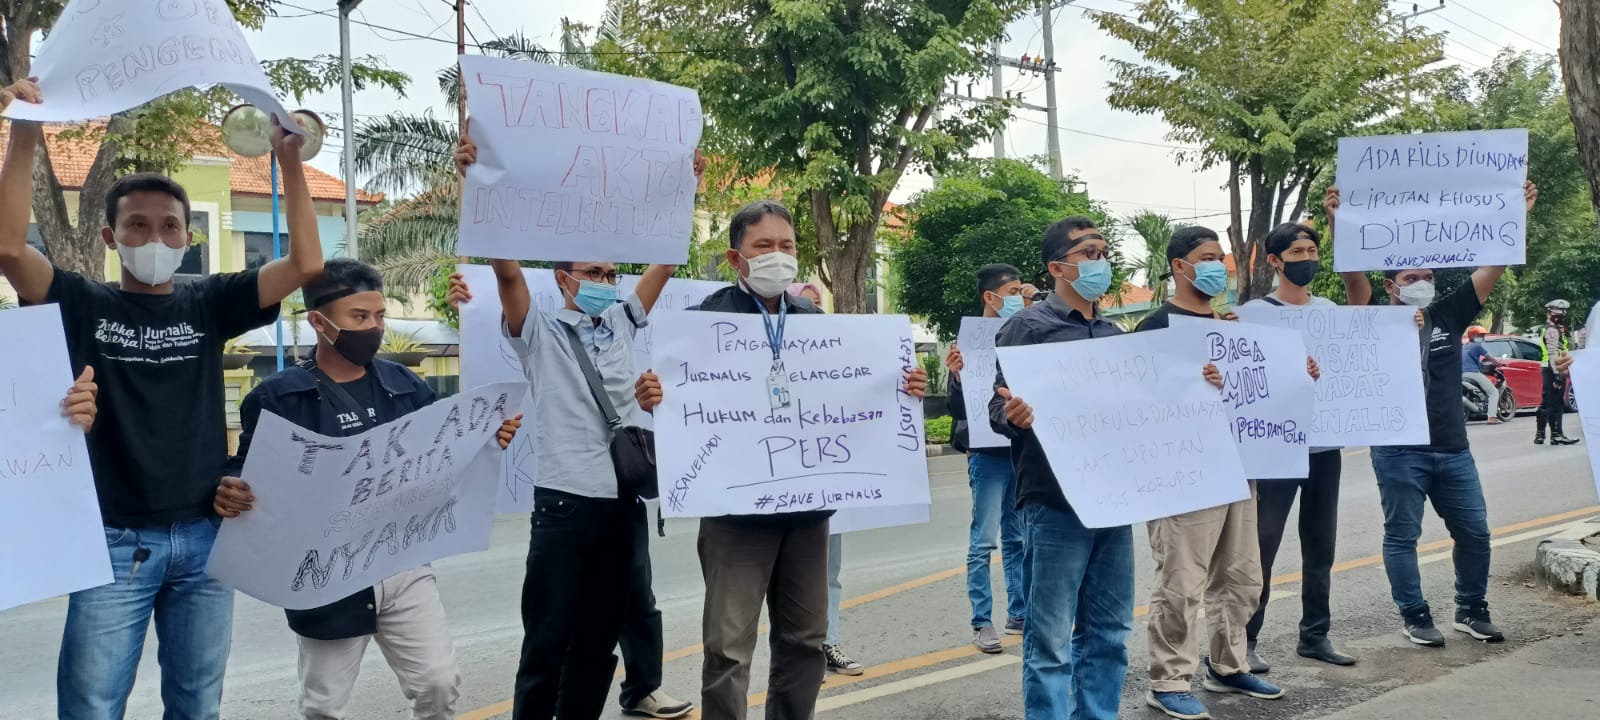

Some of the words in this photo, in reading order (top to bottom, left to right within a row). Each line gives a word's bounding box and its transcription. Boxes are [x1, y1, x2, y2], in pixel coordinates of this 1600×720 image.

[477, 72, 699, 145] TANGKAP
[1356, 146, 1401, 172] ADA
[473, 186, 686, 238] INTELEKTUAL
[1349, 187, 1430, 211] LIPUTAN
[1440, 189, 1506, 211] KHUSUS
[1360, 219, 1518, 250] DITENDANG
[144, 322, 194, 339] Jurnalis
[710, 321, 842, 354] PENGAIAYAAN
[1281, 309, 1380, 340] TOLAK
[1206, 331, 1266, 364] BACA
[1305, 343, 1379, 373] ASAN
[676, 361, 751, 387] JURNALIS
[1221, 366, 1270, 410] MOU
[684, 402, 756, 427] HUKUM
[763, 407, 791, 424] dan
[291, 420, 412, 476] TAK
[434, 392, 508, 444] ADA
[757, 434, 851, 477] PERS
[351, 444, 454, 506] BERITA
[291, 496, 457, 592] NYAWA
